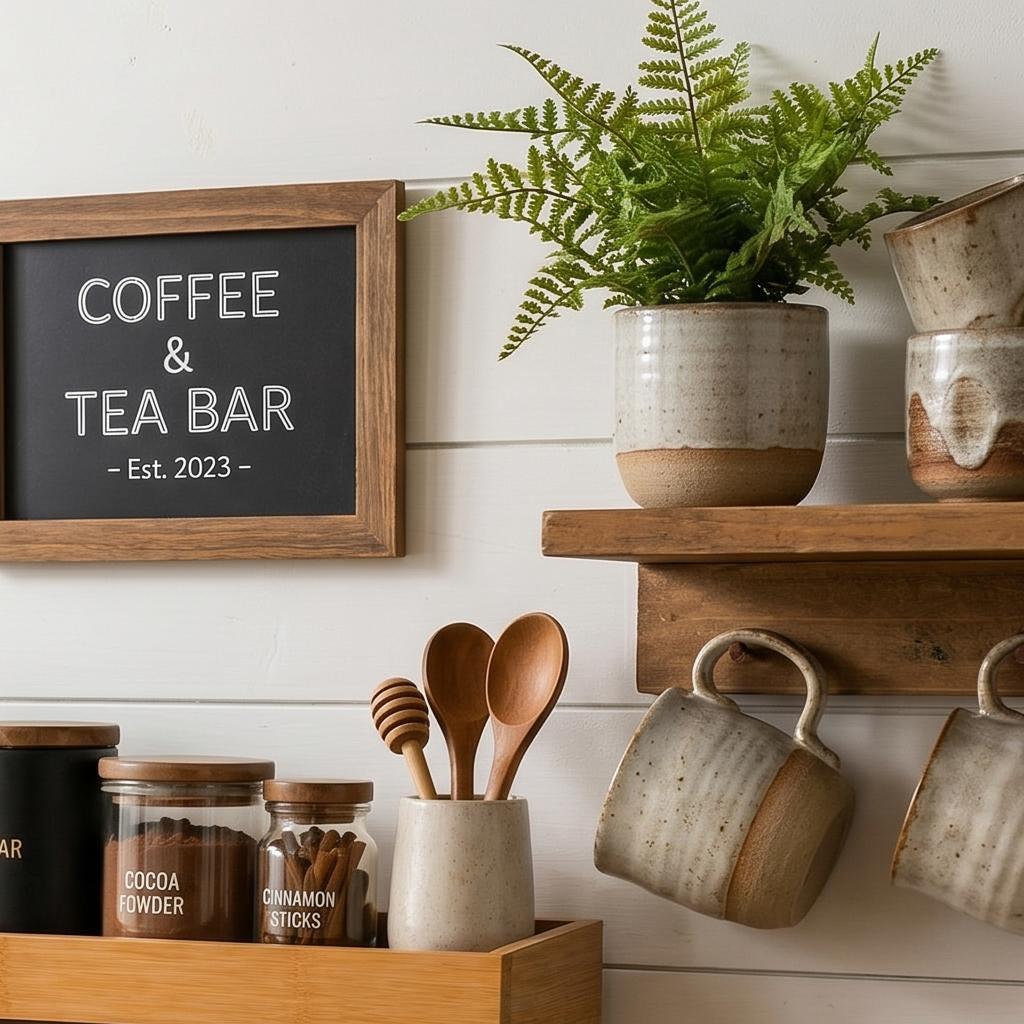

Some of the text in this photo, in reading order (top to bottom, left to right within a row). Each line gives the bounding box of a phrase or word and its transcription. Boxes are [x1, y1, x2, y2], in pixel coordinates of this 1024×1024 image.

[77, 270, 280, 325] COFFEE
[163, 335, 194, 374] &
[64, 385, 295, 436] TEA BAR
[127, 457, 167, 480] Est.
[174, 455, 232, 479] 2023
[124, 870, 180, 892] COCOA
[262, 888, 336, 908] CINNAMON
[270, 909, 321, 929] STICKS
